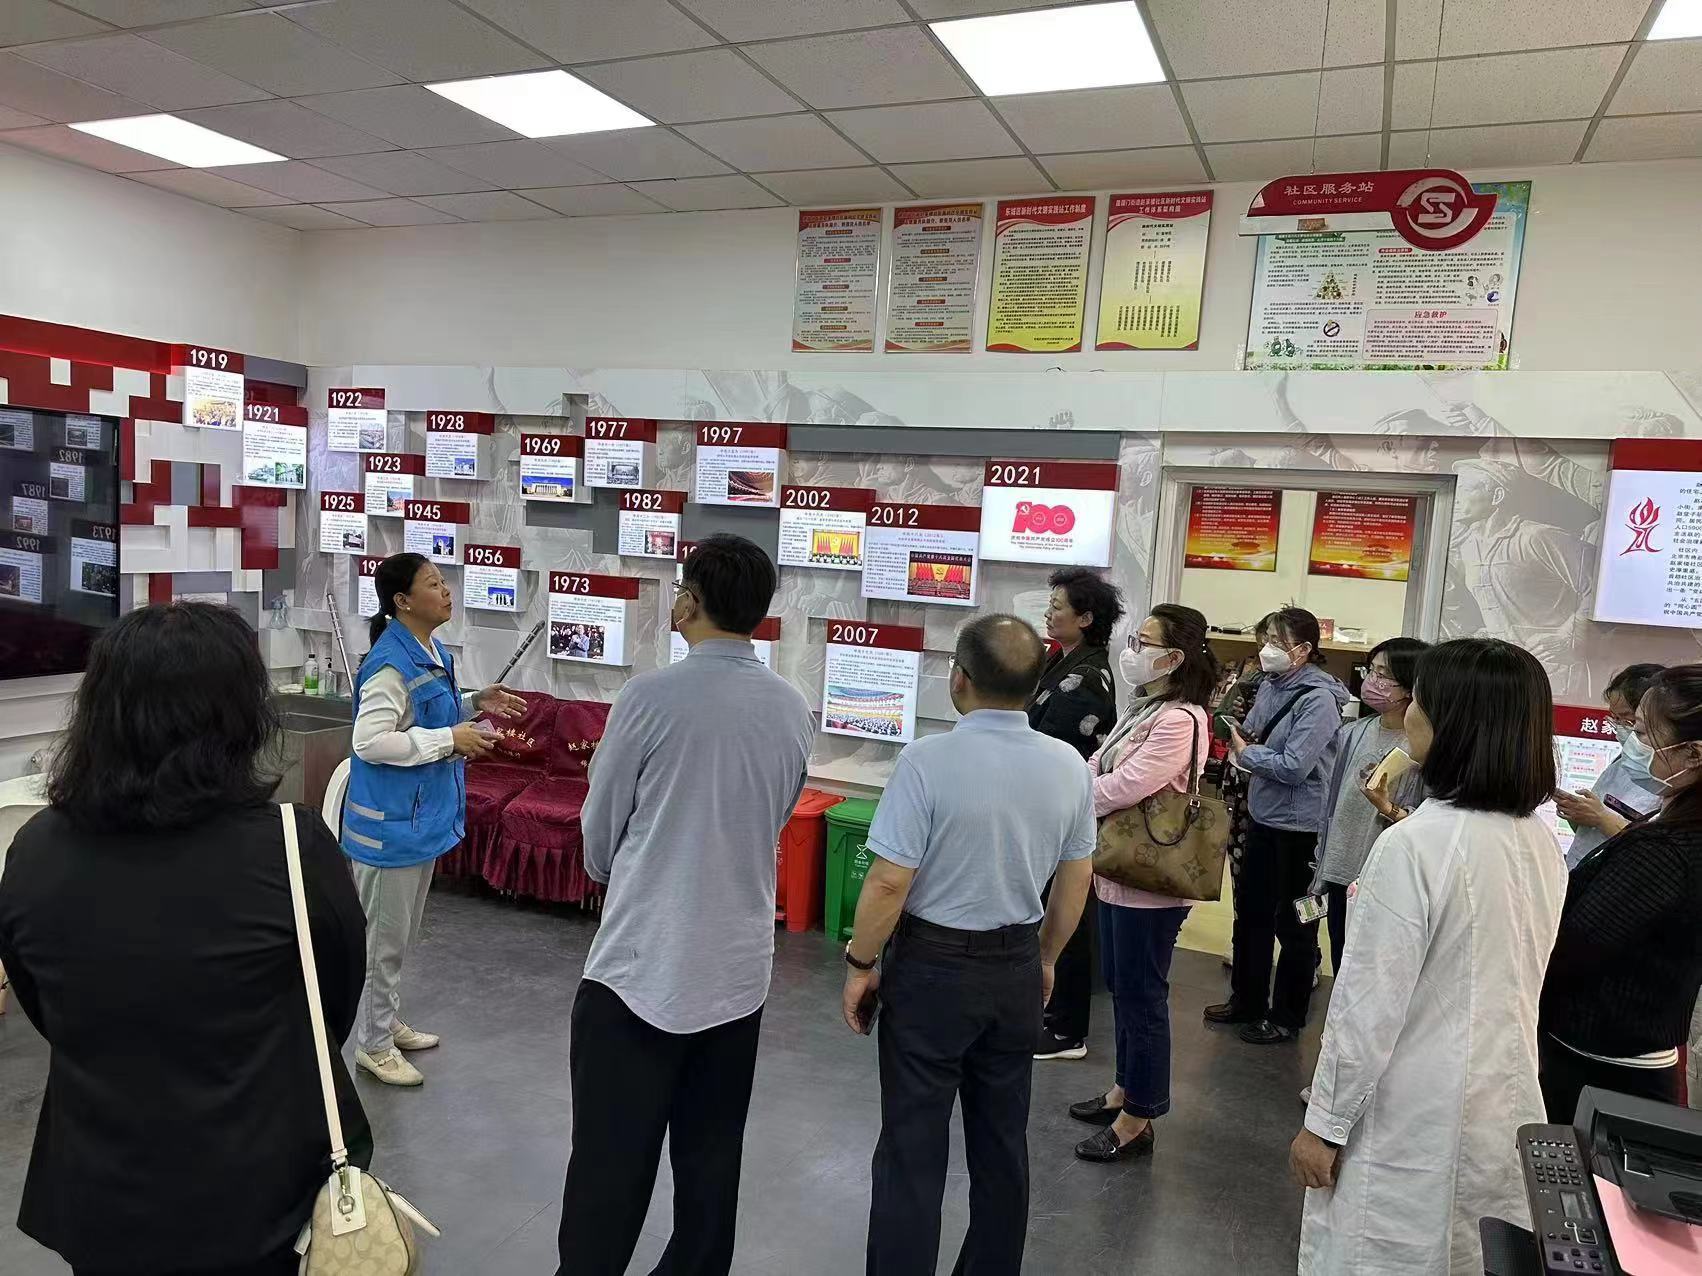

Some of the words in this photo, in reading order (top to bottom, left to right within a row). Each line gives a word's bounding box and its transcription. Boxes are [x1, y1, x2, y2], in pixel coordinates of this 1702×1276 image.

[1284, 181, 1375, 196] 社区服务站
[1293, 198, 1332, 206] COMMUNITY
[1334, 196, 1363, 204] SERVICE
[1414, 310, 1448, 319] 应急救护
[190, 348, 229, 370] 1919
[331, 392, 363, 407] 1922
[247, 404, 280, 422] 1921
[430, 414, 465, 430] 1928
[589, 421, 628, 438] 1977
[702, 426, 743, 444] 1997
[524, 438, 561, 454] 1969
[368, 456, 401, 472] 1923
[990, 465, 1041, 485] 2021
[323, 494, 355, 510] 1925
[624, 492, 662, 510] 1982
[786, 489, 830, 508] 2002
[407, 504, 441, 520] 1945
[871, 506, 919, 527] 2012
[467, 548, 504, 564] 1956
[553, 575, 590, 594] 1973
[832, 624, 879, 645] 2007
